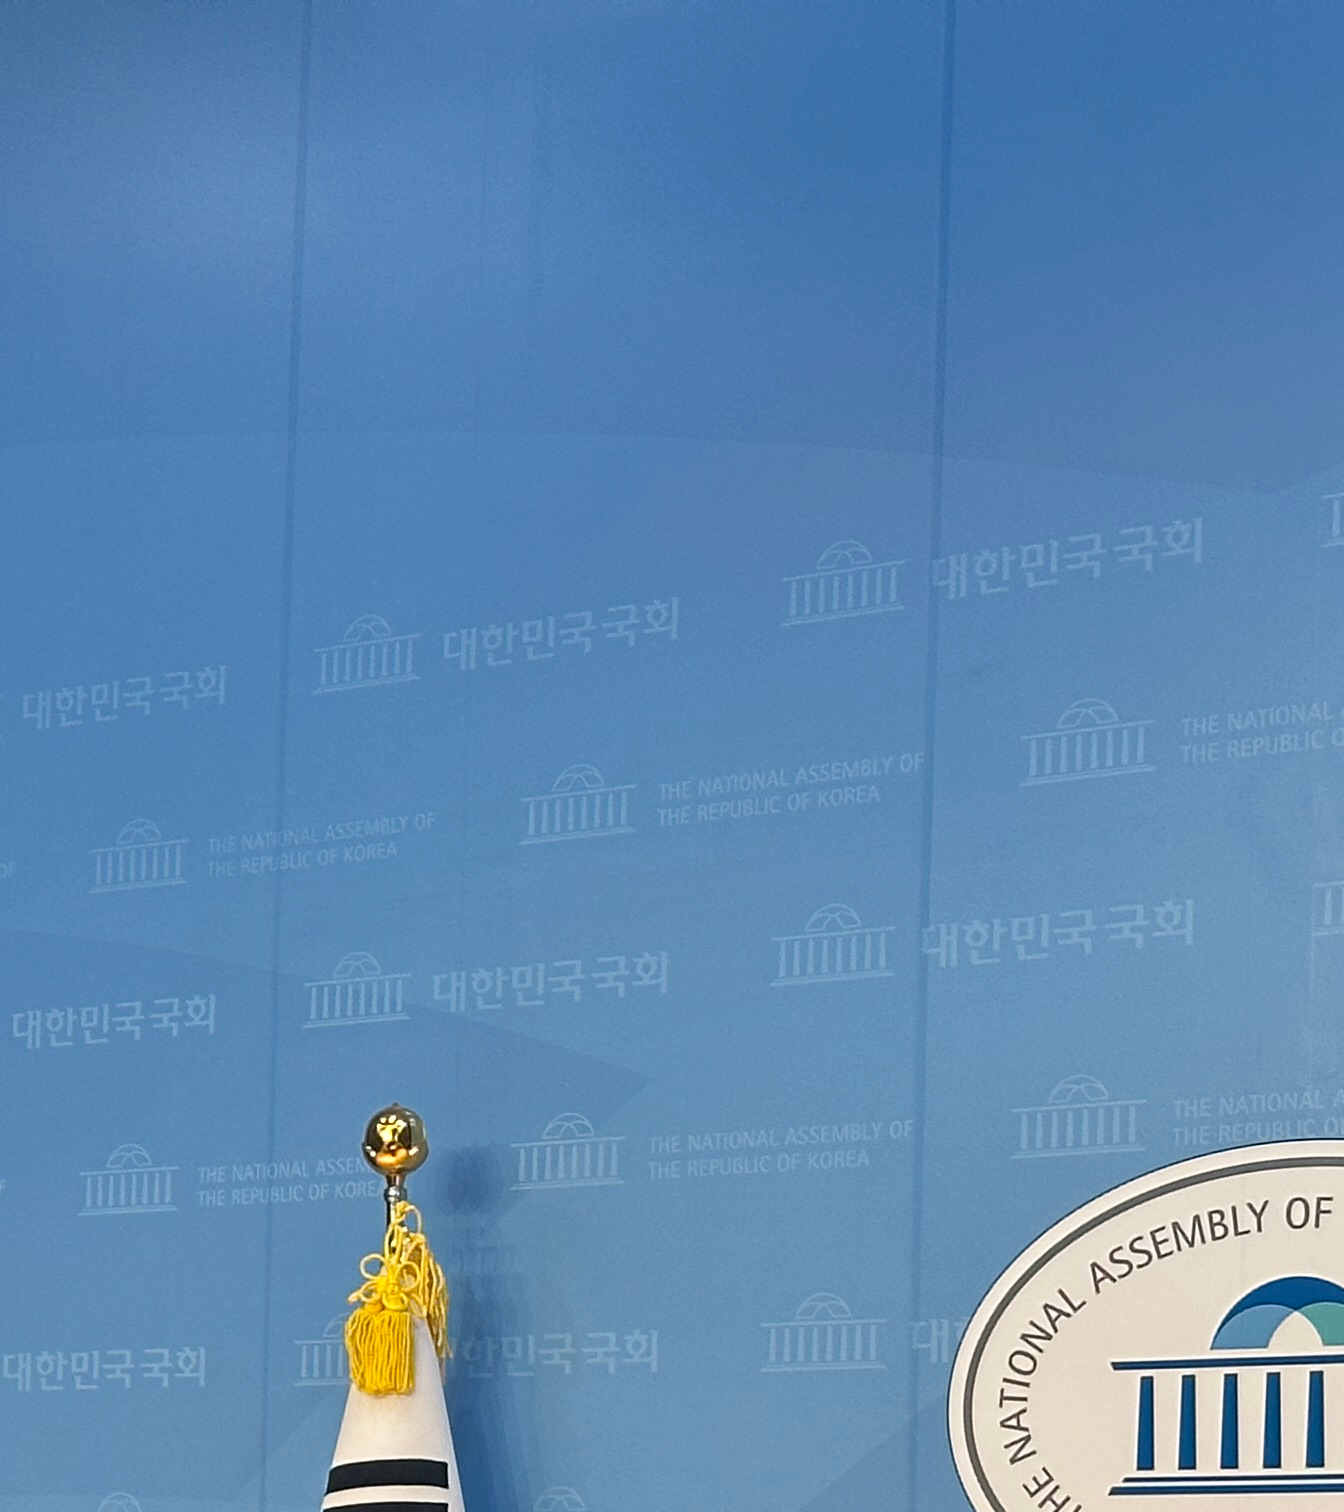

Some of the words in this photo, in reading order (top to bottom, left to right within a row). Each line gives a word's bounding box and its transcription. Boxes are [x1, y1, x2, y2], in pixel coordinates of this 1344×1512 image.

[932, 517, 1203, 600] 대한민국국회
[444, 597, 678, 670] 대한민국국회
[23, 665, 227, 730] 대한민국국회
[1181, 714, 1219, 737] THE
[1227, 701, 1332, 731] NATIONAL
[1180, 742, 1219, 764] THE
[1226, 730, 1325, 759] REPUBLIC
[658, 781, 691, 800] THE
[698, 769, 790, 796] NATIONAL
[795, 755, 895, 784] ASSEMBLY
[899, 752, 925, 773] OF
[657, 805, 690, 826] THE
[697, 796, 781, 823] REPUBLIC
[787, 792, 812, 812] OF
[817, 785, 881, 808] KOREA
[209, 835, 236, 853] THE
[241, 827, 319, 850] NATIONAL
[324, 815, 409, 841] ASSEMBLY
[414, 812, 436, 830] OF
[208, 860, 235, 877] THE
[241, 851, 312, 875] REPUBLIC
[318, 848, 338, 867] OF
[344, 841, 397, 862] KOREA
[922, 898, 1193, 968] 대한민국국회
[433, 951, 669, 1013] 대한민국국회
[12, 993, 216, 1049] 대한민국국회
[1173, 1097, 1211, 1118] THE
[1218, 1089, 1324, 1116] NATIONAL
[648, 1135, 680, 1154] THE
[687, 1129, 779, 1152] NATIONAL
[784, 1121, 883, 1145] ASSEMBLY
[889, 1119, 913, 1138] OF
[198, 1165, 227, 1183] THE
[232, 1161, 310, 1182] NATIONAL
[648, 1160, 680, 1180] THE
[687, 1154, 771, 1177] REPUBLIC
[776, 1152, 801, 1172] OF
[808, 1148, 870, 1170] KOREA
[198, 1189, 226, 1207] THE
[231, 1184, 303, 1205] REPUBLIC
[308, 1183, 329, 1201] OF
[999, 1286, 1088, 1464] NATIONAL
[1087, 1197, 1271, 1296] ASSEMBLY
[1284, 1195, 1334, 1230] OF
[3, 1346, 206, 1391] 대한민국국회
[449, 1328, 659, 1377] 한민국국회
